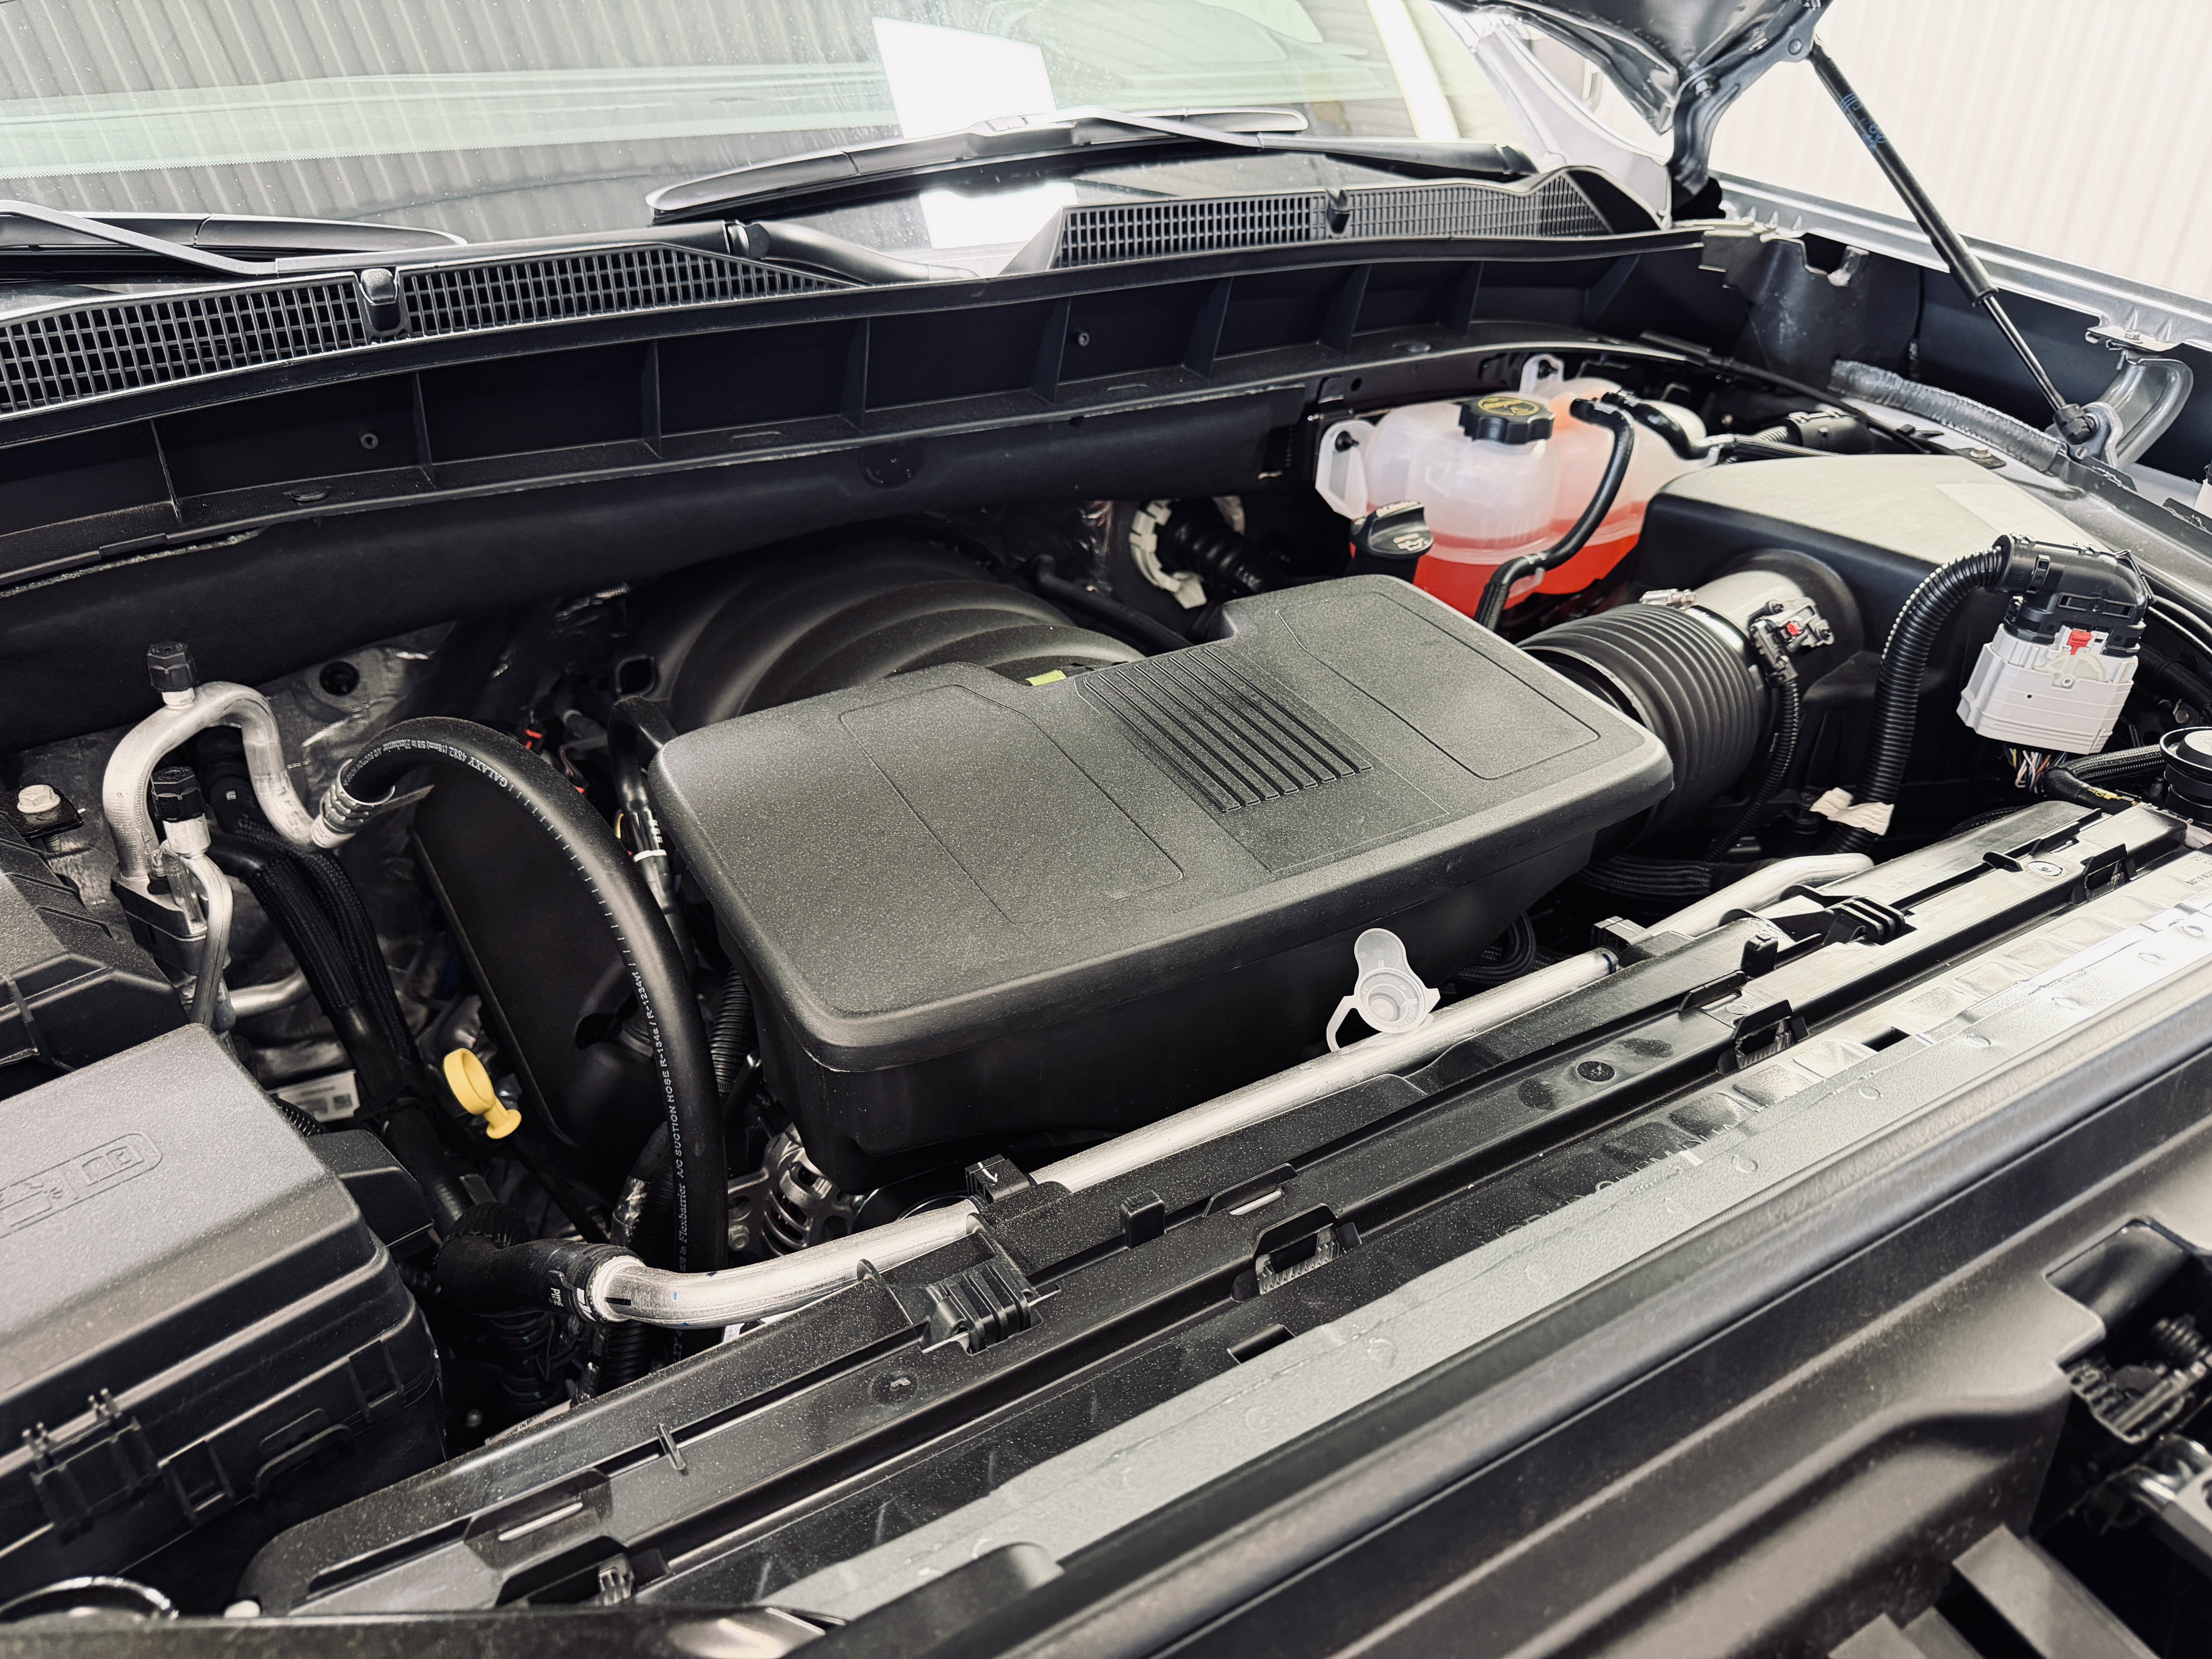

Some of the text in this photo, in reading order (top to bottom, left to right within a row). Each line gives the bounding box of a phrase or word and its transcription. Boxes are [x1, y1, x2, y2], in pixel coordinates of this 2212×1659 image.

[449, 746, 467, 762] 4882
[467, 756, 508, 788] GALAXY
[653, 1027, 667, 1067] R-134a
[662, 1070, 675, 1103] HOSE
[669, 1105, 682, 1157] SUCTION
[675, 1159, 684, 1178] A/C
[678, 1183, 688, 1244] Flexbarrier
